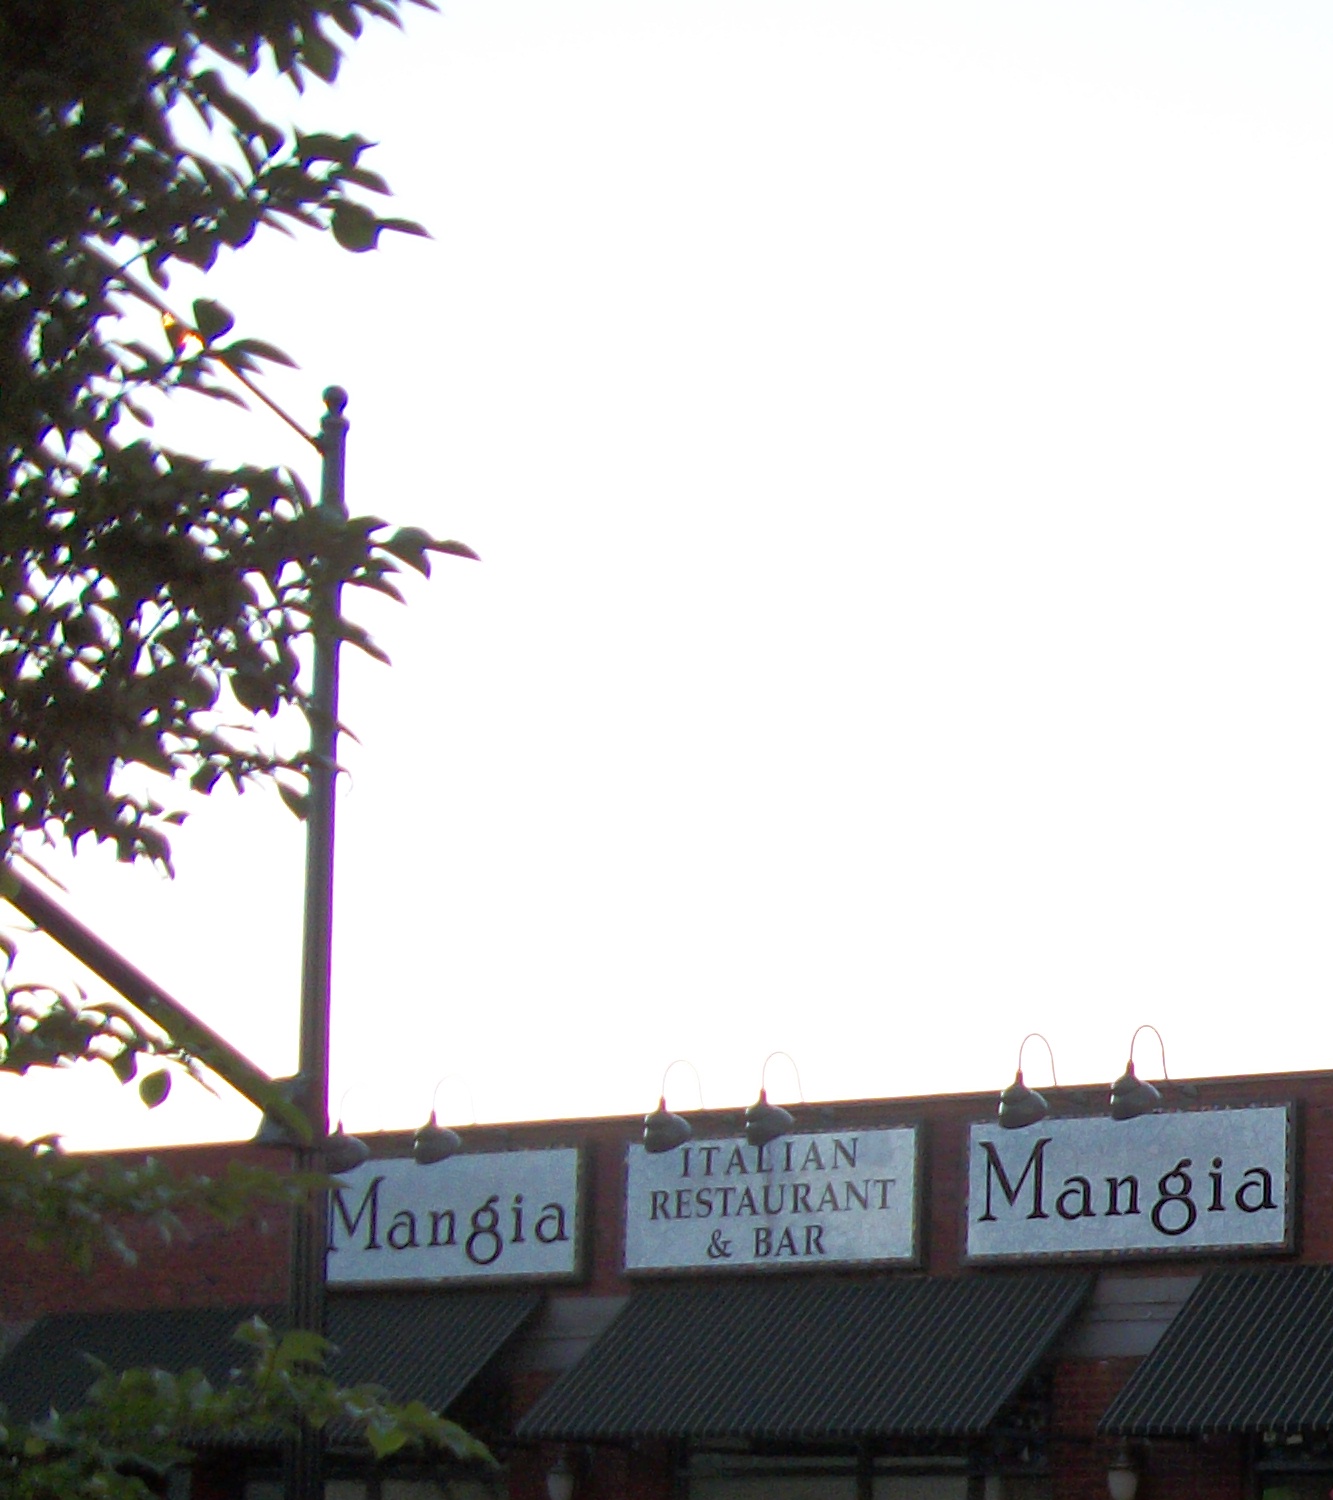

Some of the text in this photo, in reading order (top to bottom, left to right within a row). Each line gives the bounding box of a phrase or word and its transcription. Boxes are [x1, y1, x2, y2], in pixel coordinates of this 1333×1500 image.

[680, 1136, 860, 1178] ITALIAN
[649, 1177, 897, 1221] RESTAURANT
[978, 1136, 1279, 1237] Mangia
[326, 1175, 570, 1266] Mangia
[706, 1223, 827, 1260] & BAR
